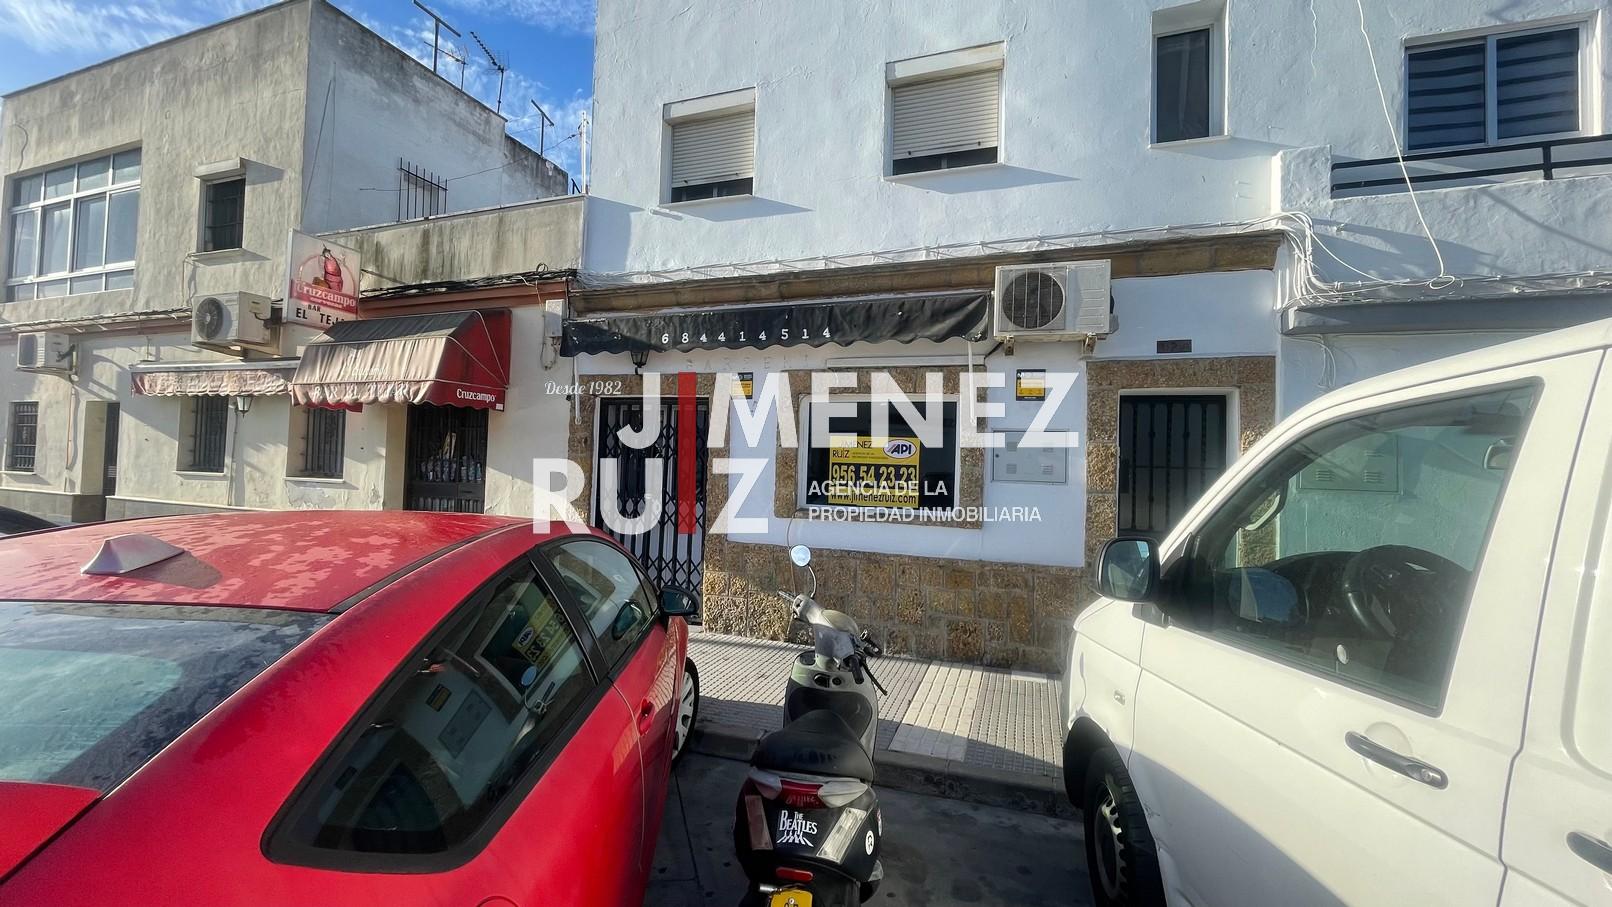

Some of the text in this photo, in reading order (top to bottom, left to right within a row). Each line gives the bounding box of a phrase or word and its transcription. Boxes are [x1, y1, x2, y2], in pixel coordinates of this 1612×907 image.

[296, 281, 357, 307] Cruzcampo
[295, 307, 308, 320] EL
[308, 304, 321, 312] BAR
[456, 388, 496, 404] Cruzcampo
[889, 443, 912, 455] API
[832, 464, 916, 488] 956 54 23 23
[779, 810, 818, 835] BEATLES
[794, 811, 804, 821] THE
